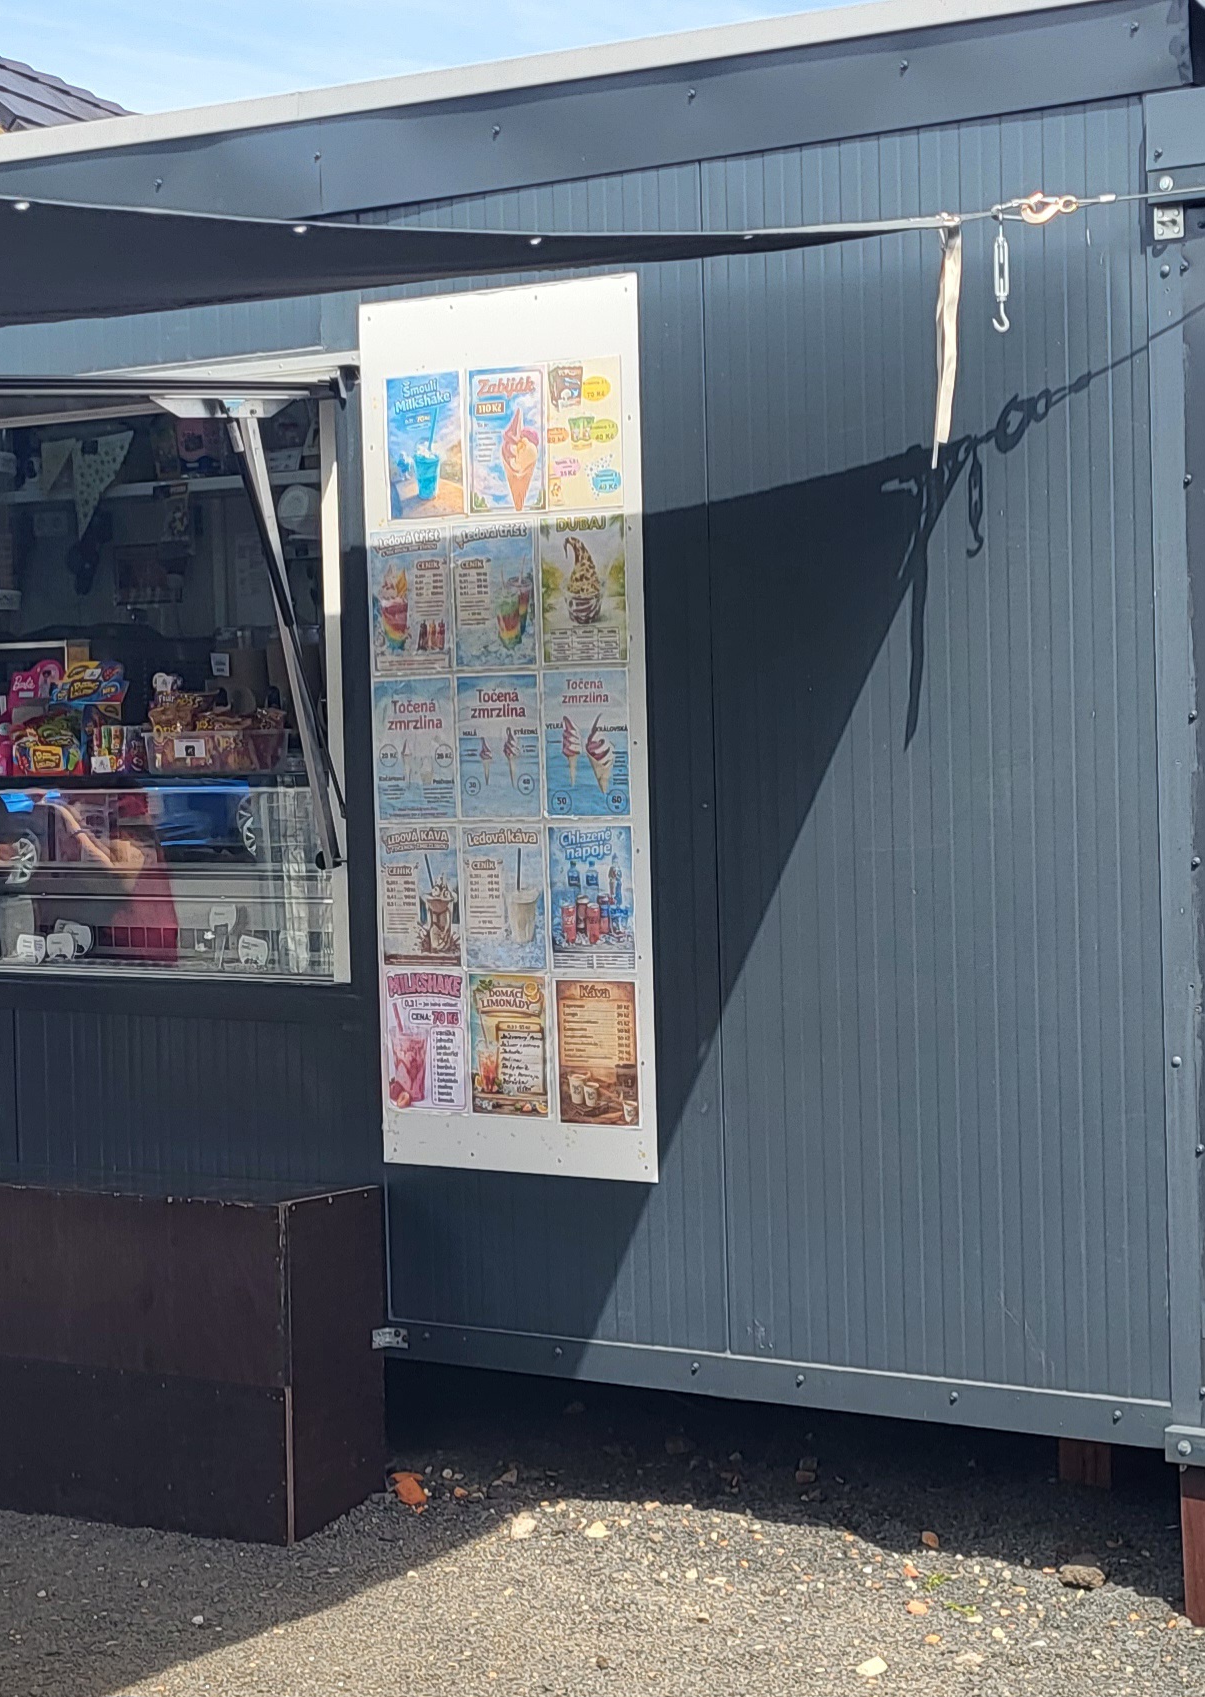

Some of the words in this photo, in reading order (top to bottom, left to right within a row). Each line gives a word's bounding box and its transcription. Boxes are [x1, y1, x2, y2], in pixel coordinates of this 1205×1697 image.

[402, 378, 438, 398] Šmoulí
[477, 376, 536, 398] Zabiják
[395, 391, 452, 414] Milkshake
[478, 403, 491, 413] 110
[556, 516, 606, 532] DUBAJ
[379, 532, 414, 548] Ledová
[461, 526, 496, 542] Ledová
[13, 675, 35, 691] Barbie
[566, 678, 603, 690] Točená
[476, 688, 519, 703] Točená
[562, 692, 609, 704] zmrzlina
[392, 699, 436, 714] Točená
[471, 704, 526, 719] zmrzlina
[387, 715, 443, 730] zmrzlina
[596, 723, 628, 732] KRÁLOVSKÁ
[557, 797, 566, 805] 50
[611, 796, 621, 804] 60
[420, 828, 449, 842] KÁVA
[467, 828, 506, 847] Ledová
[507, 828, 538, 844] káva
[559, 829, 611, 847] Chlazené
[566, 843, 612, 860] nápoje
[472, 859, 496, 870] CENÍK
[388, 973, 462, 998] MILKSHAKE
[579, 985, 610, 998] Káva
[489, 988, 523, 999] DOMÁCÍ
[481, 999, 531, 1010] LIMONÁDY
[411, 1013, 432, 1021] CENA:
[432, 1011, 445, 1025] 70
[447, 1011, 459, 1025] Kč
